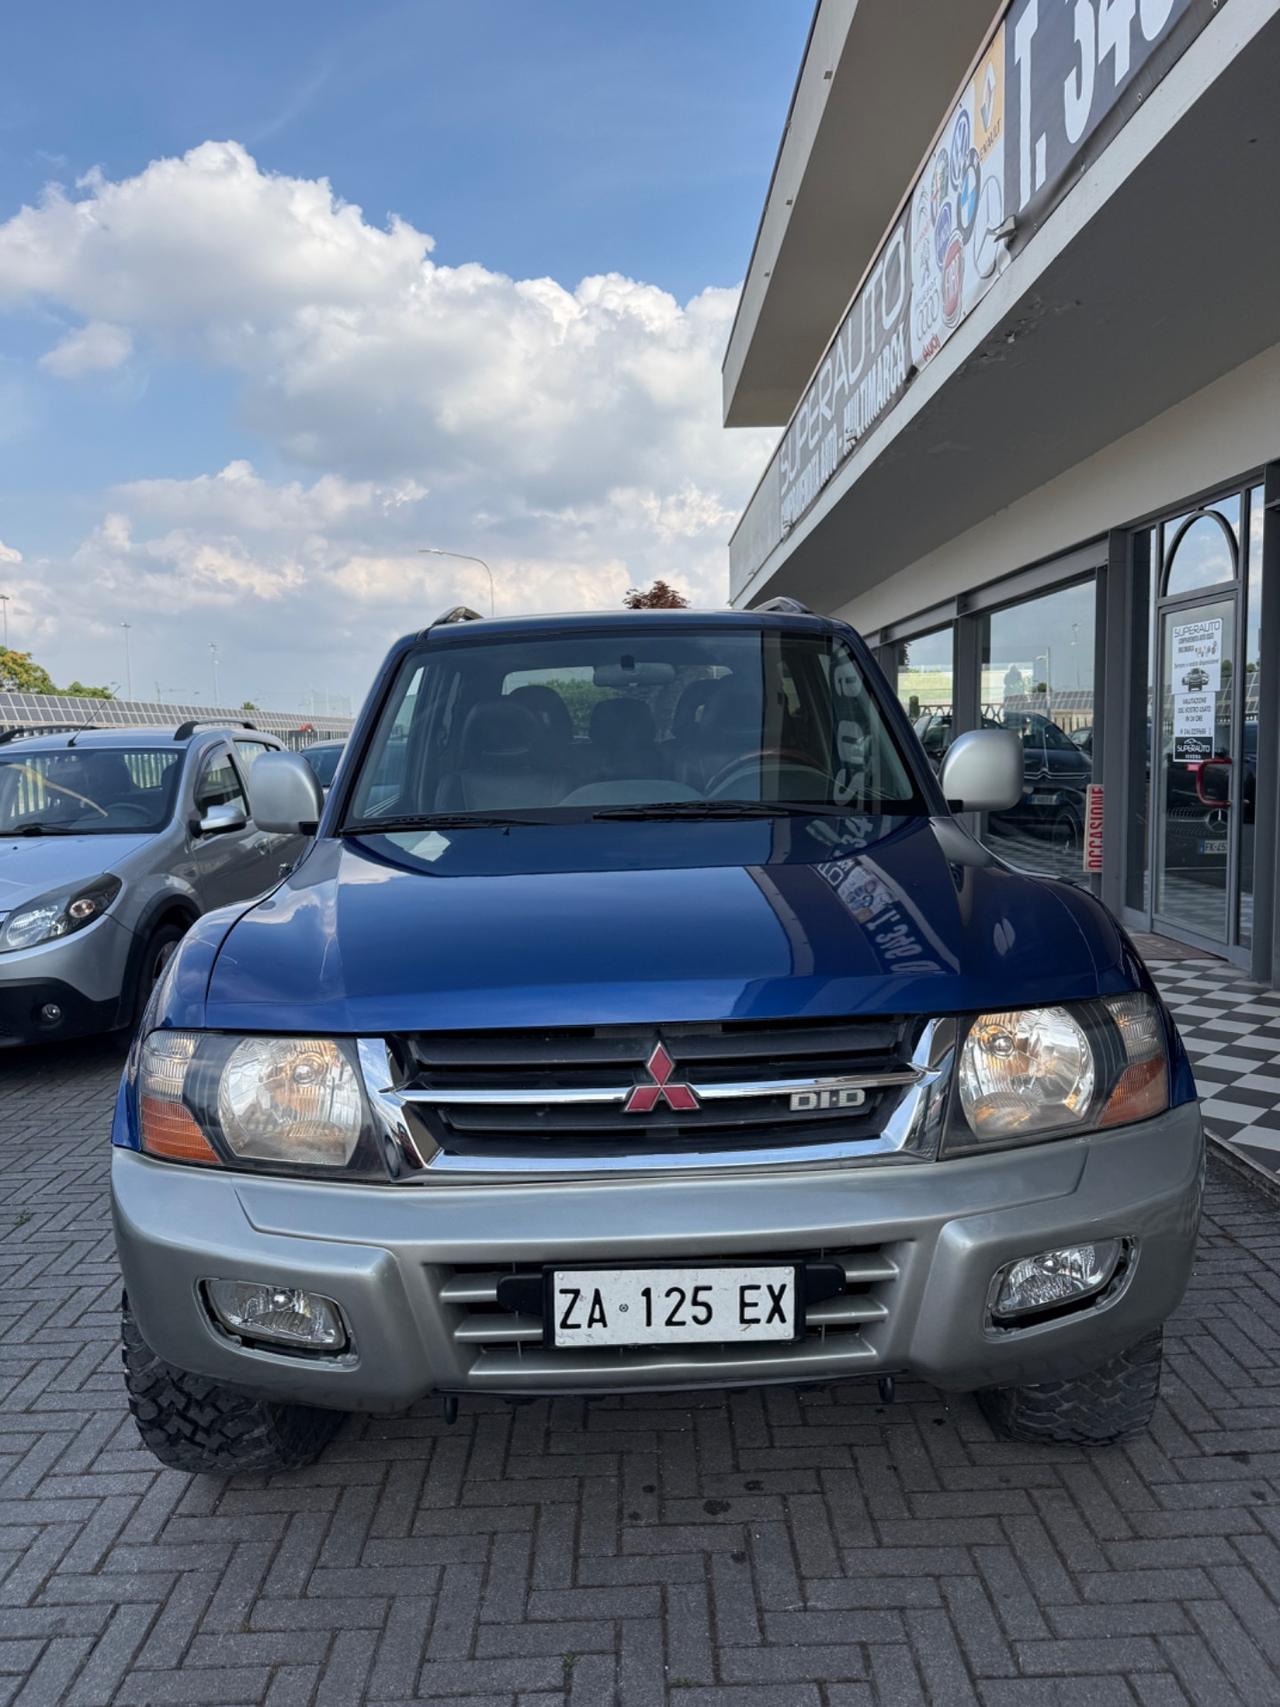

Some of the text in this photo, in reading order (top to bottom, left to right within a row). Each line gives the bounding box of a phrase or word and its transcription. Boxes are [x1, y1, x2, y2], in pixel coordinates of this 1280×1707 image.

[780, 226, 905, 497] SUPERAUTO
[1174, 620, 1220, 638] SUPERAUTO
[1176, 744, 1210, 753] SUPERAUTO
[1088, 787, 1104, 869] OCCASIONE
[559, 1283, 787, 1329] ZA 125 EX
